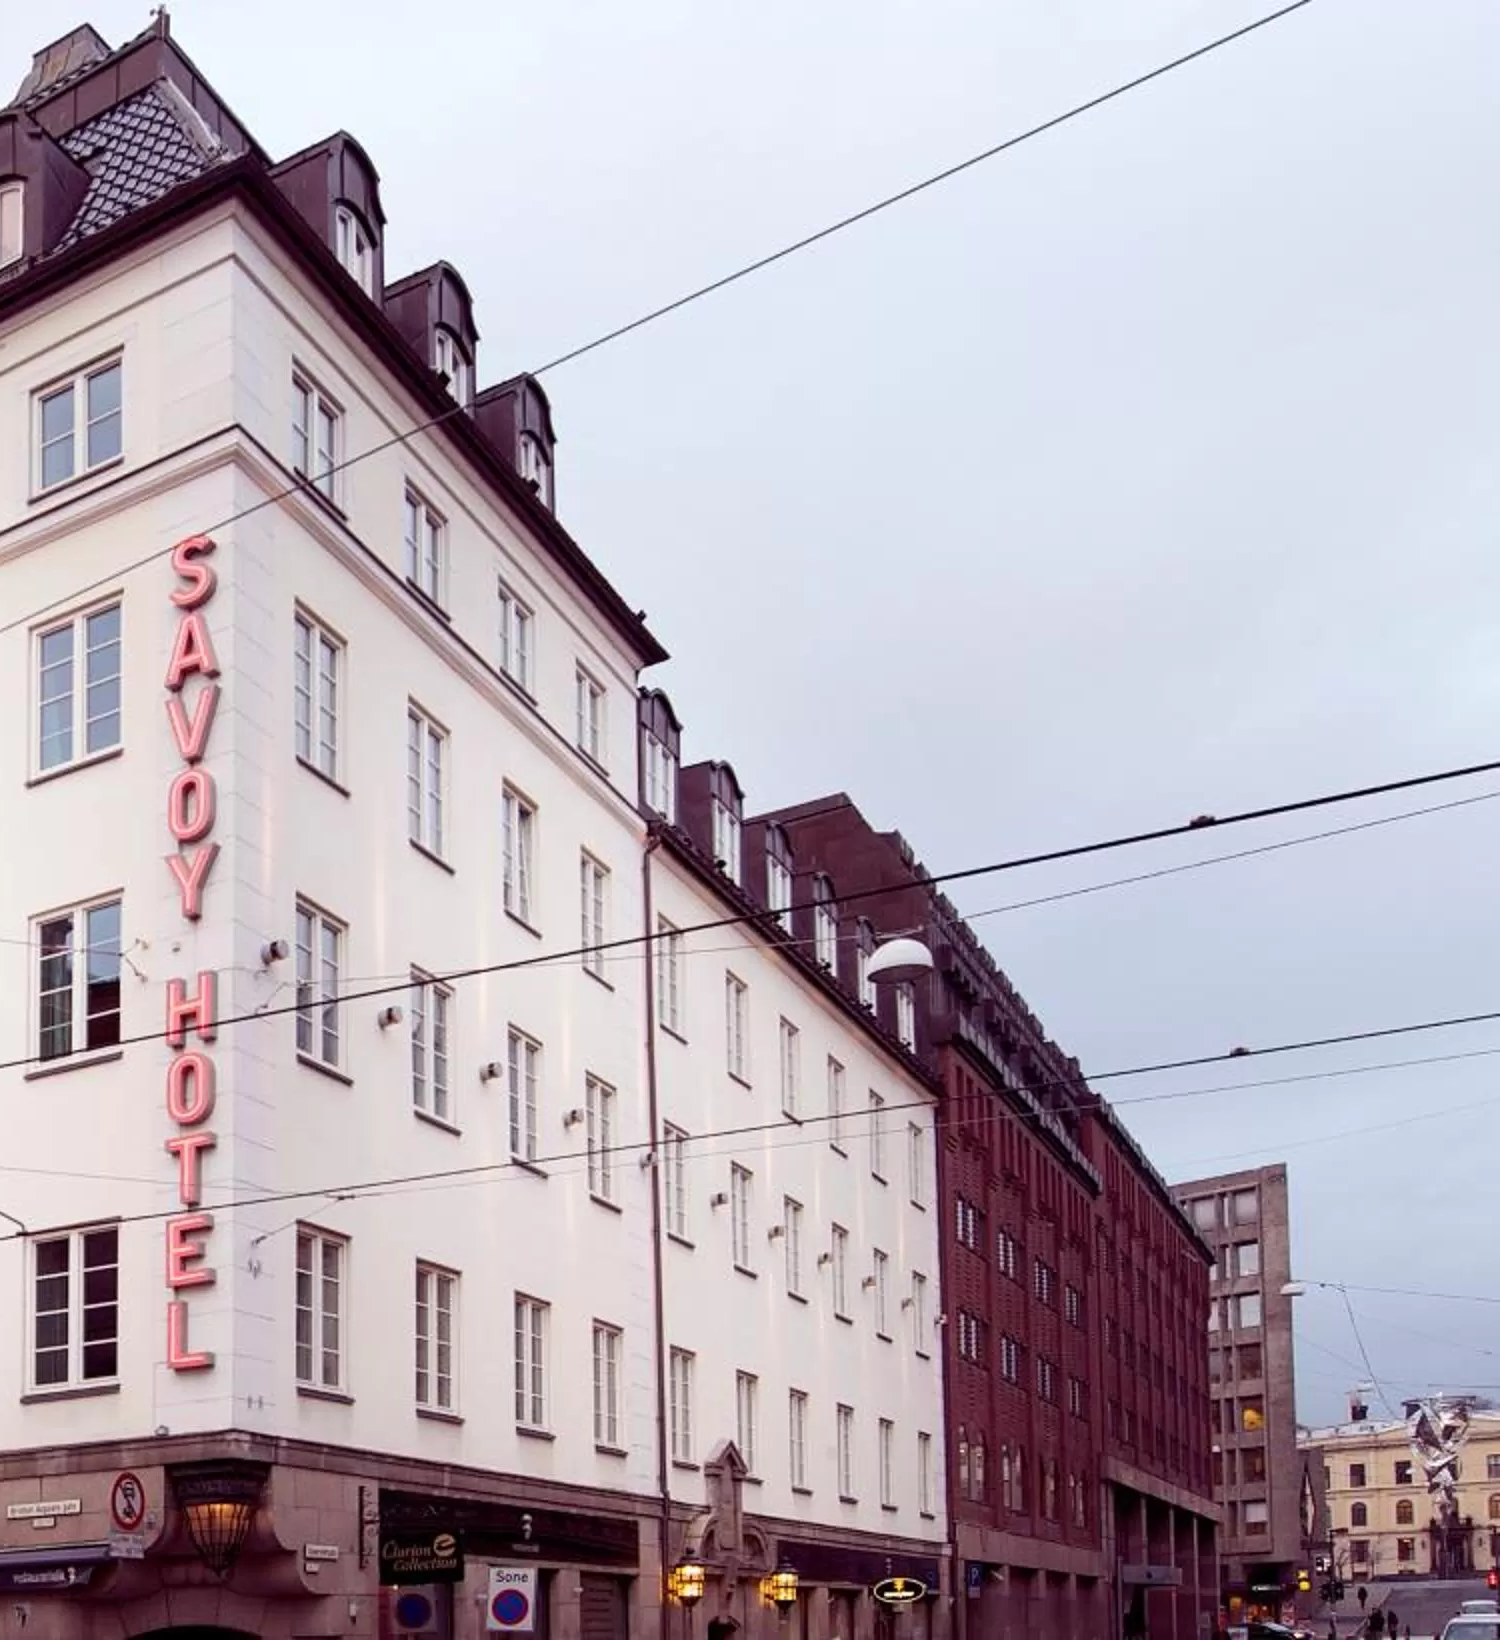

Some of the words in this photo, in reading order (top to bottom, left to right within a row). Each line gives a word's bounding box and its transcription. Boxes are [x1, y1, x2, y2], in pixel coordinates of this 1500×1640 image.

[164, 534, 222, 924] SAVOY
[165, 968, 218, 1372] HOTEL
[382, 1540, 431, 1560] Clarion
[393, 1556, 457, 1571] Collection
[496, 1570, 529, 1583] Sone
